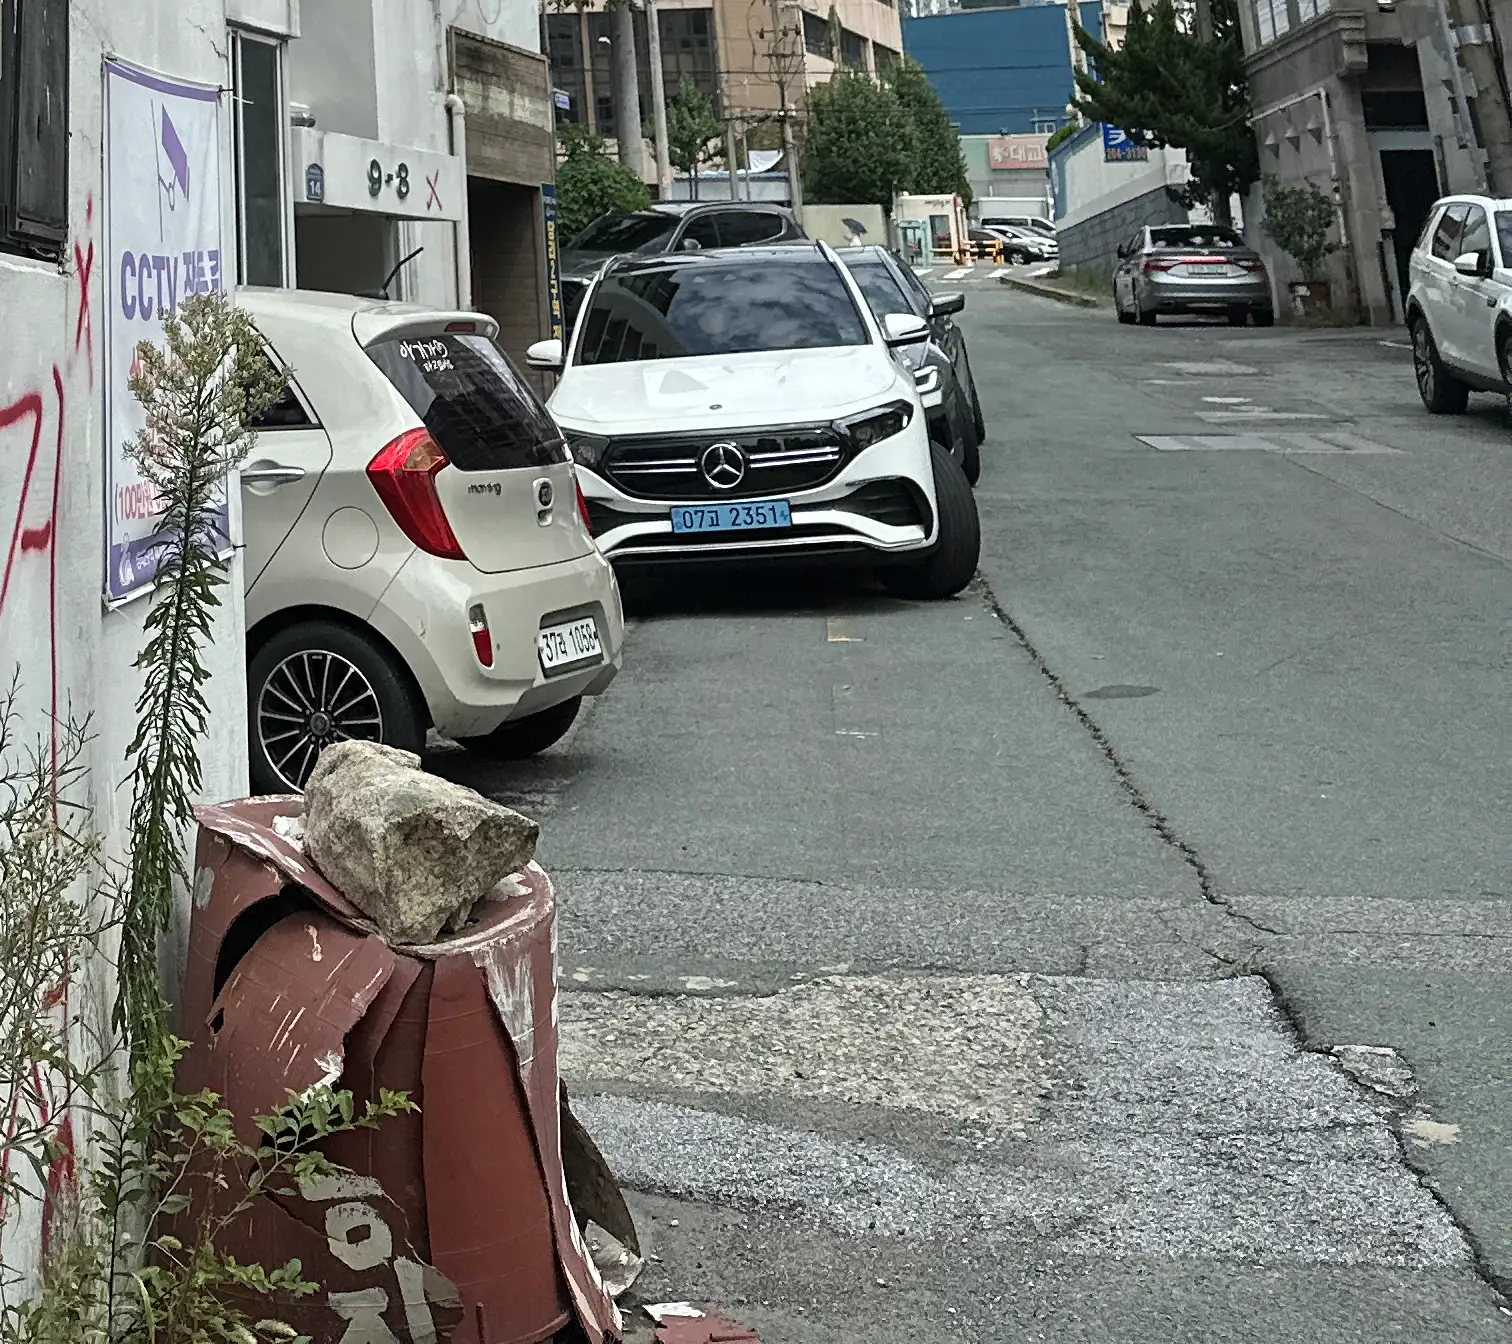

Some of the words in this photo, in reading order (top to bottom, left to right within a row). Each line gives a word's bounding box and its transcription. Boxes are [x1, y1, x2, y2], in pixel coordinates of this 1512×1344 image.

[309, 180, 322, 196] 14
[121, 250, 178, 322] CCTV
[728, 505, 778, 528] 2351
